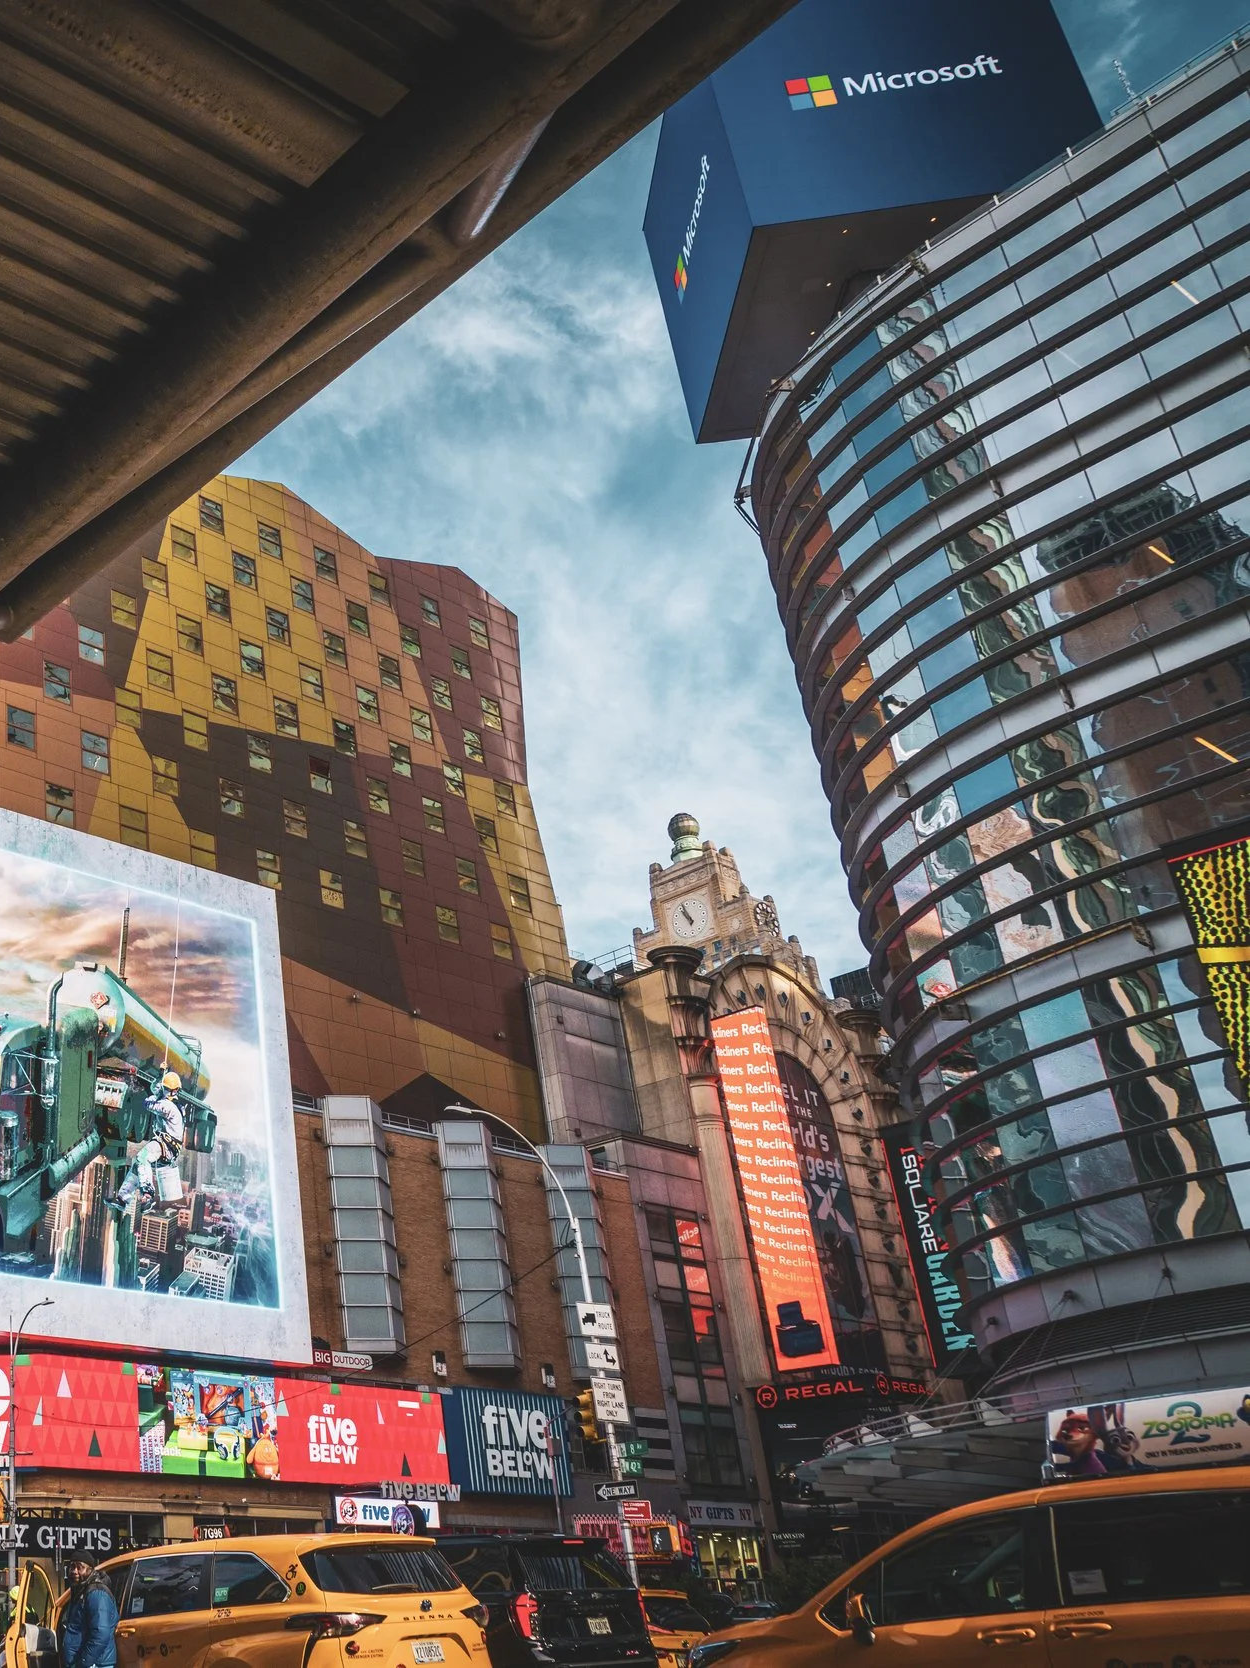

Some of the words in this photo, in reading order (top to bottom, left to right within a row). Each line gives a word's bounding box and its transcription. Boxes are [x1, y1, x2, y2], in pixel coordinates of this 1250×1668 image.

[842, 54, 1003, 97] Microsoft
[681, 154, 710, 266] Microsoft
[805, 1089, 818, 1106] IT
[795, 1105, 812, 1117] THE
[763, 1221, 810, 1237] Recliners
[768, 1237, 814, 1253] Recliners
[314, 1352, 331, 1364] BIG
[333, 1355, 370, 1367] OUTDOOR
[589, 1352, 602, 1360] LOCAL
[594, 1382, 606, 1390] RIGHT
[784, 1379, 864, 1400] REGAL
[597, 1400, 610, 1408] RIGHT
[307, 1415, 357, 1446] five
[482, 1405, 549, 1449] five
[1141, 1413, 1236, 1439] ZOOTOPIA
[309, 1443, 359, 1464] BELOW
[630, 1444, 635, 1455] 8
[486, 1448, 554, 1480] BELOW
[381, 1481, 414, 1499] five
[415, 1483, 461, 1502] BELOW
[618, 1486, 633, 1494] WAY
[362, 1505, 389, 1520] five
[690, 1506, 702, 1518] NY
[706, 1507, 735, 1520] GIFTS
[739, 1509, 752, 1520] NY
[36, 1526, 112, 1551] GIFTS
[203, 1528, 223, 1540] 7G96
